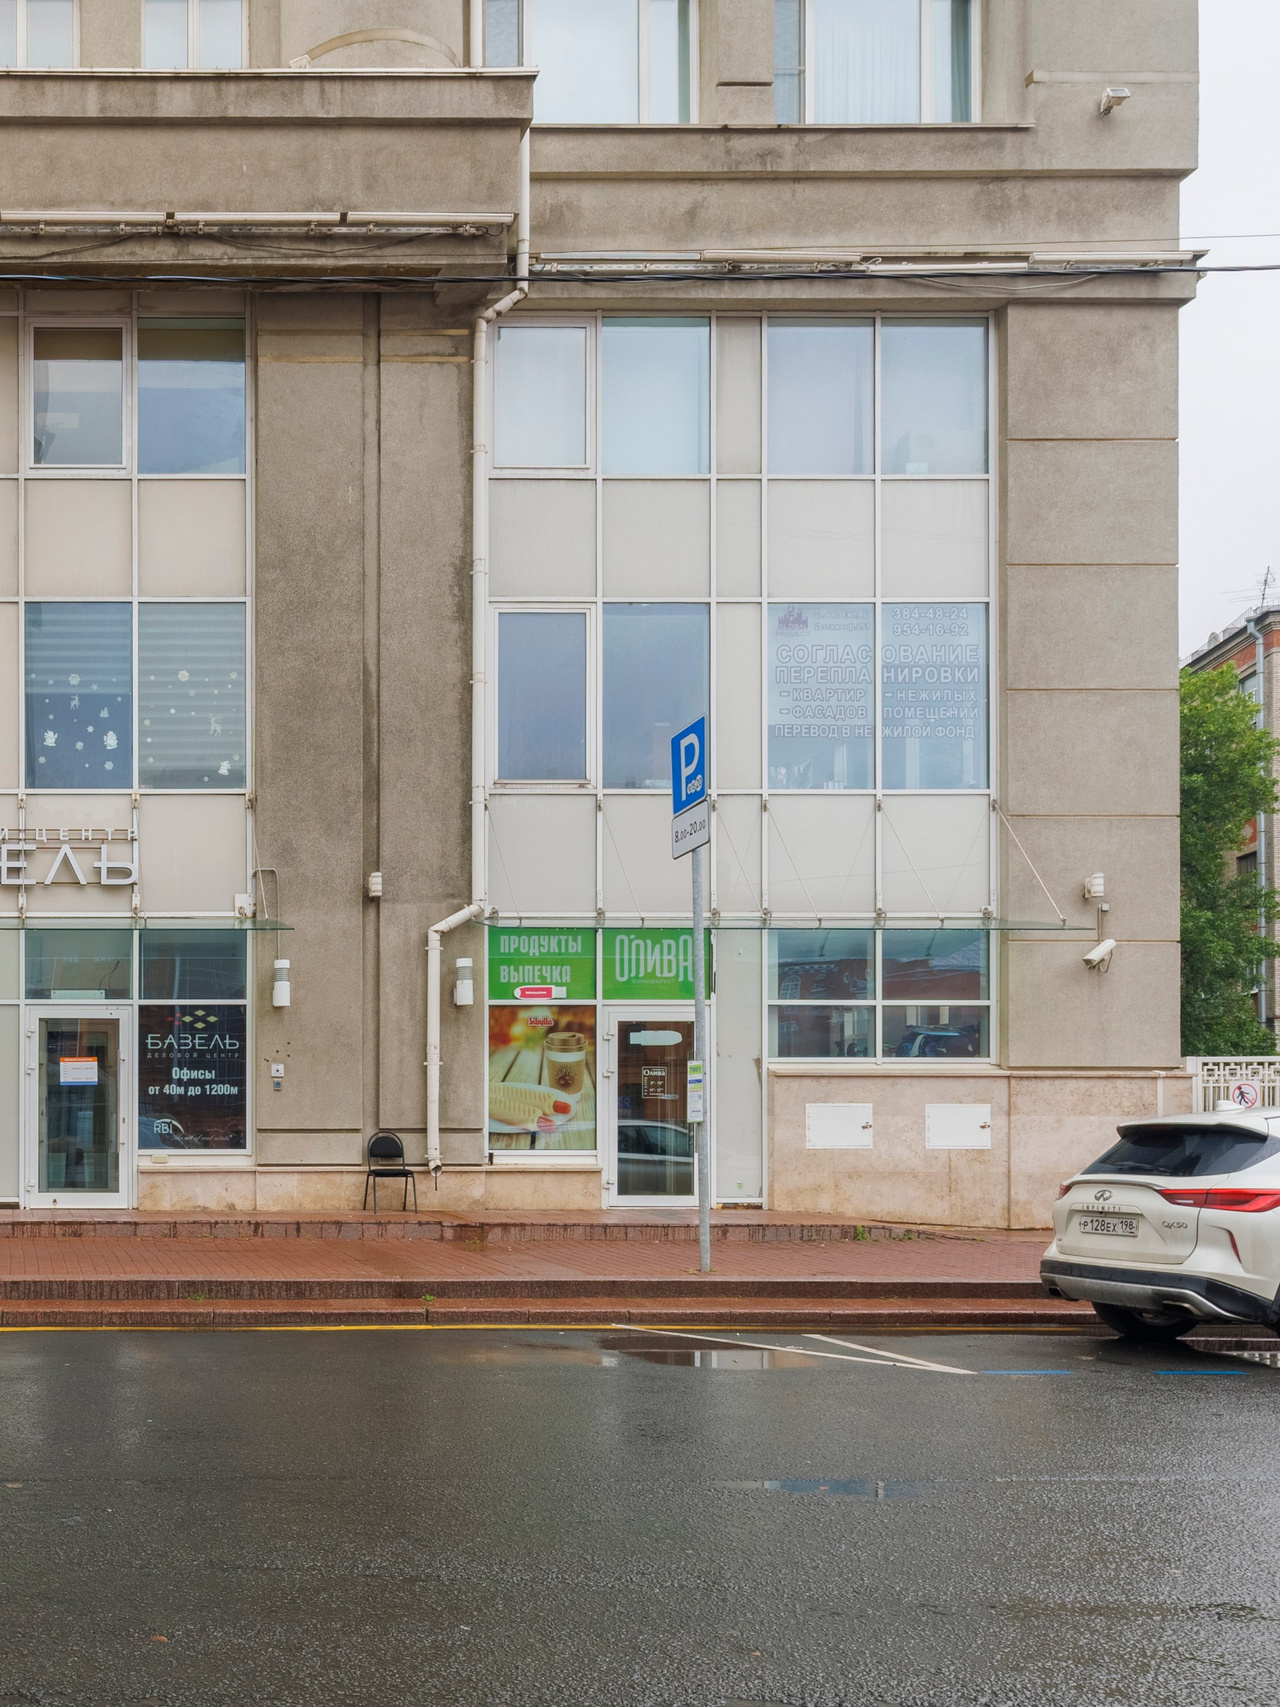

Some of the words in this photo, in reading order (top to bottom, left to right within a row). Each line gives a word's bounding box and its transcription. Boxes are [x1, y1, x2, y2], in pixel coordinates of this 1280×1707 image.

[892, 607, 969, 620] 384-48-24
[778, 622, 809, 630] GLOBAL
[814, 622, 820, 631] 2
[892, 623, 969, 636] 954-16-92
[883, 702, 979, 720] ПОМЕЩЕНИЙ
[775, 724, 838, 740] ПЕРЕВОД
[842, 725, 852, 738] В
[935, 725, 975, 740] ФОНД
[680, 733, 700, 802] P
[35, 828, 138, 843] ЦЕНТР
[674, 819, 707, 843] 8.00-20.00
[500, 935, 582, 956] ПРОДУКТЫ
[500, 965, 571, 983] ВЫПЕЧКА
[145, 1034, 240, 1049] БАЗЕЛЬ
[172, 1067, 215, 1081] Офисы
[148, 1085, 160, 1095] от
[163, 1084, 184, 1095] 40м
[188, 1085, 201, 1096] до
[205, 1084, 238, 1095] 1200м
[153, 1123, 173, 1134] RBI
[1120, 1220, 1133, 1230] 198
[1162, 1221, 1188, 1230] QX50
